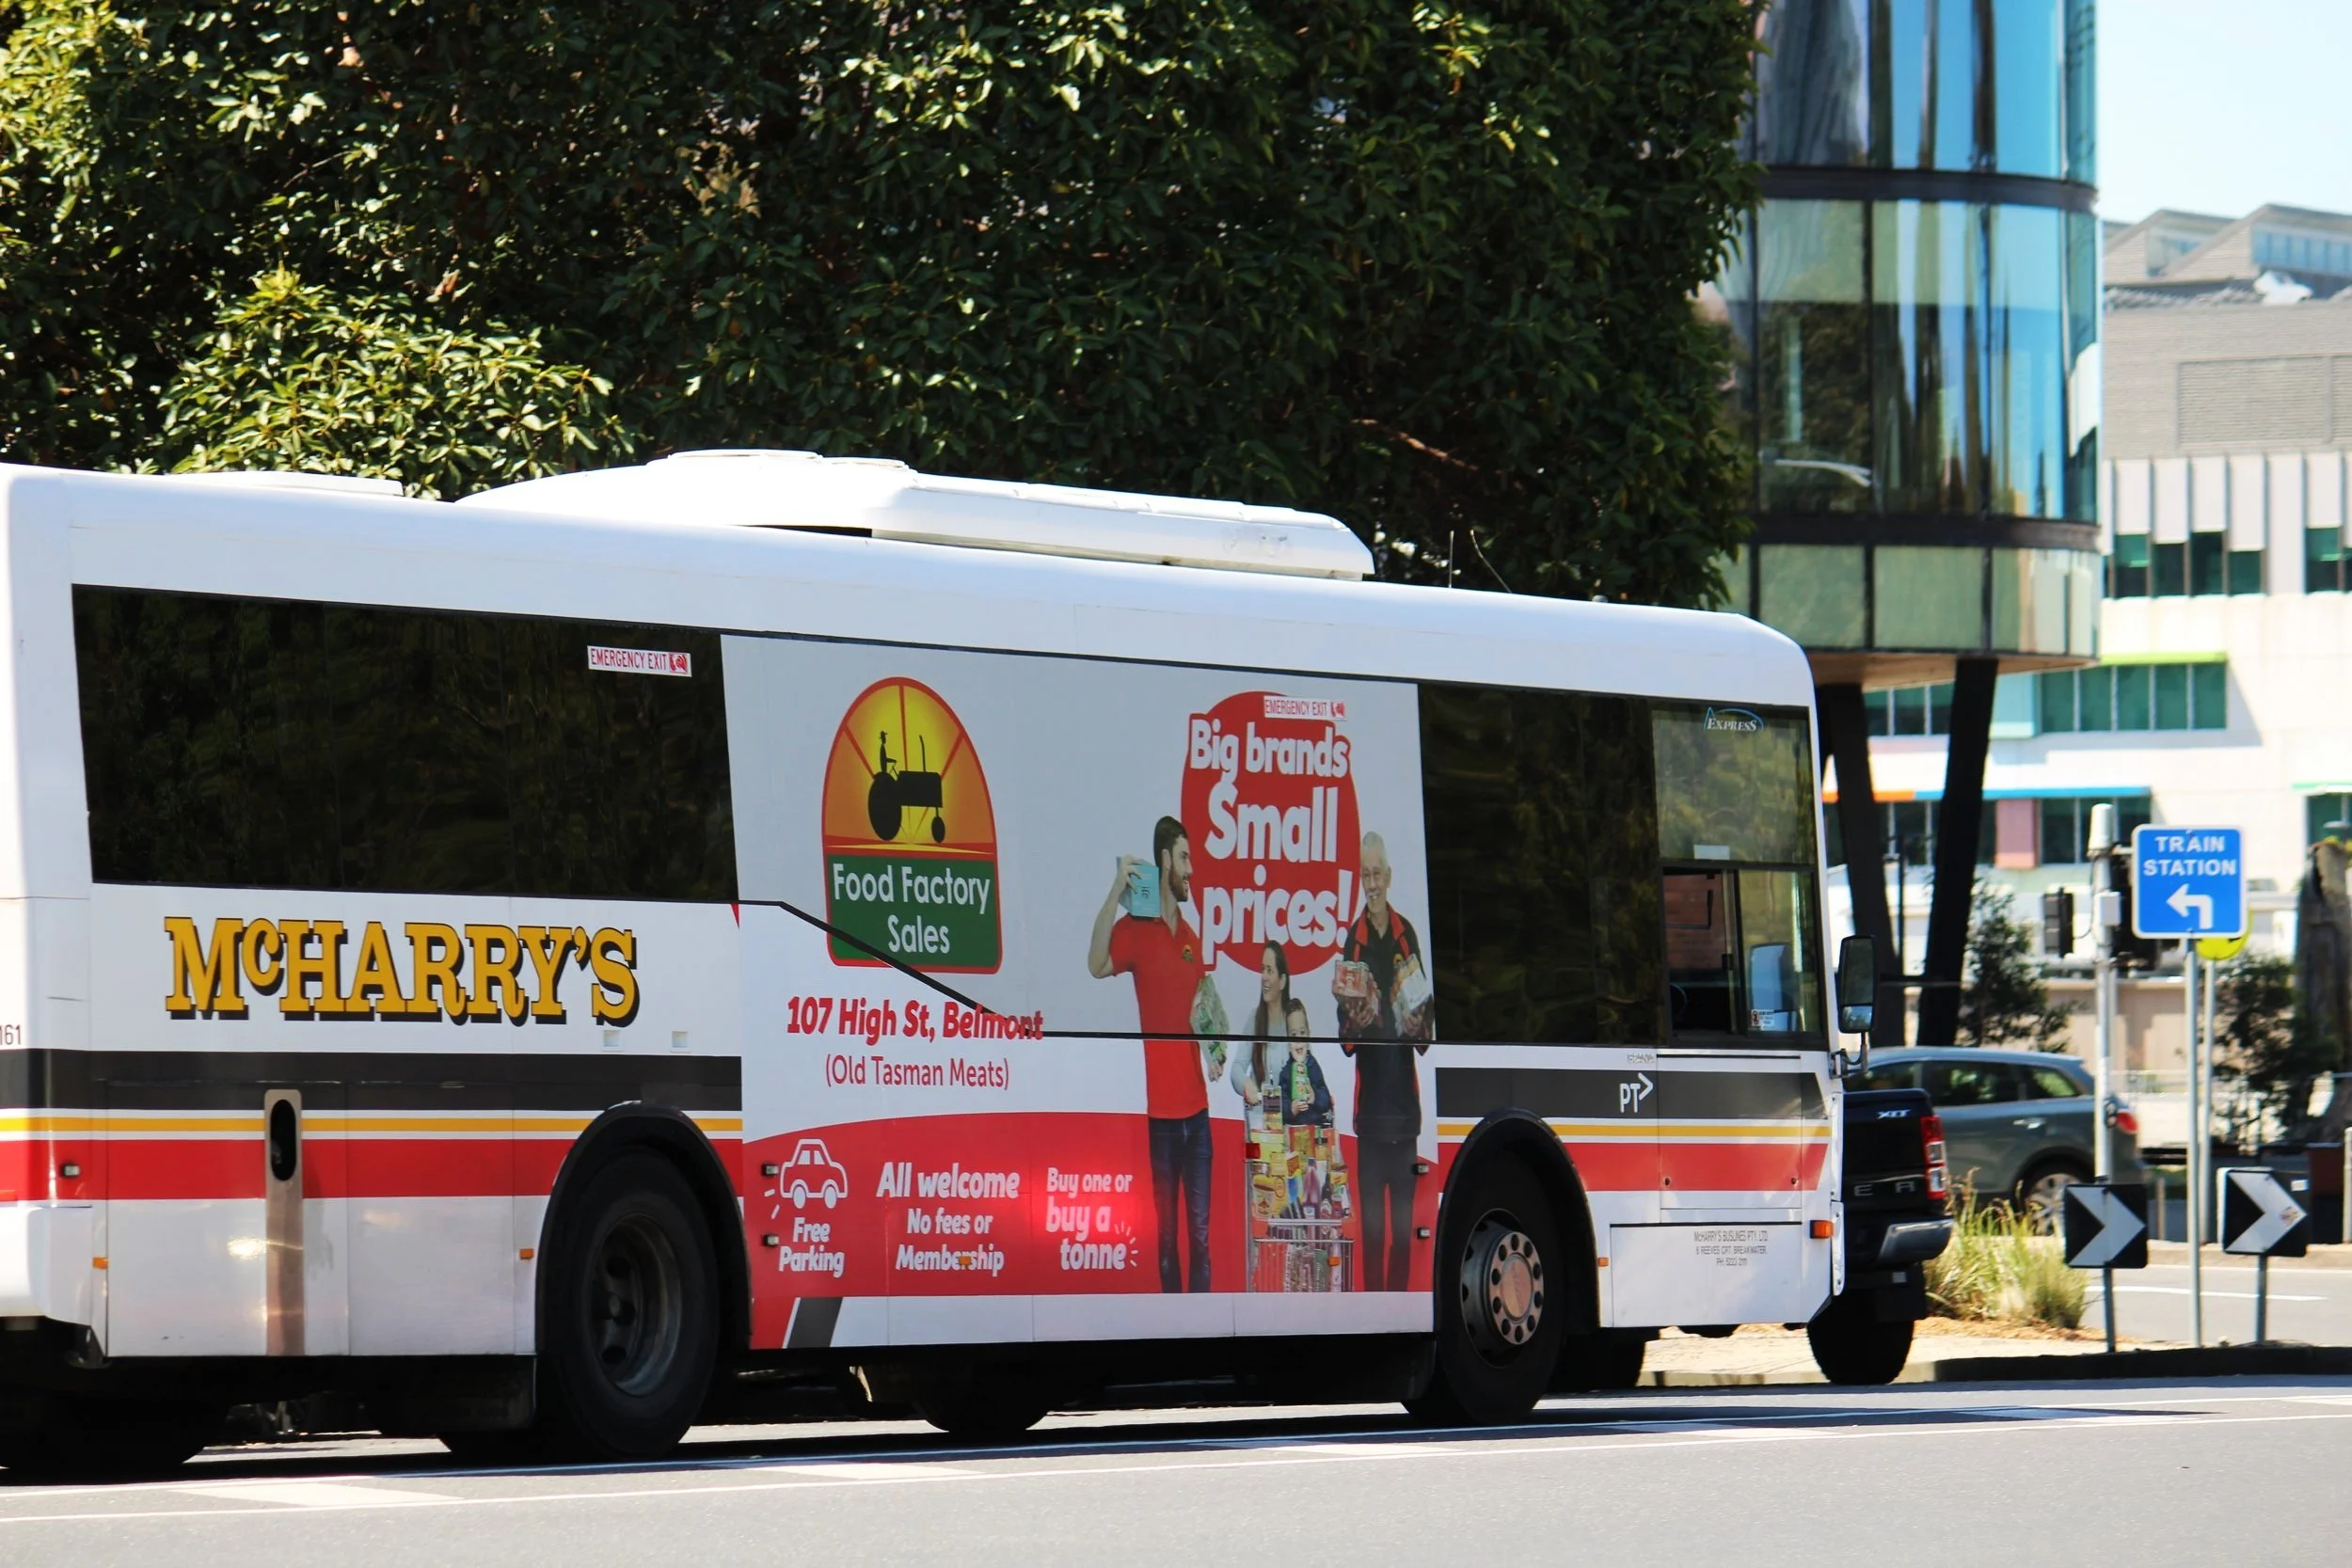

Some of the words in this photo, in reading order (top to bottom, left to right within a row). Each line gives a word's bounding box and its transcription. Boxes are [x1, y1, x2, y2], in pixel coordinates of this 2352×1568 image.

[590, 648, 645, 669] EMERGENCY
[648, 653, 667, 671] EXIT
[1265, 699, 1310, 715] EMERGENCY
[1312, 702, 1327, 716] EXIT
[1707, 718, 1757, 731] EXPRESS
[1190, 719, 1239, 783] Big
[1246, 721, 1350, 778] brands
[1204, 781, 1339, 863] Small
[2154, 835, 2225, 852] TRAIN
[2143, 859, 2236, 876] STATION
[833, 863, 894, 902] Food
[901, 866, 990, 915] Factory
[1201, 864, 1354, 965] prices!
[887, 914, 950, 954] Sales
[787, 995, 833, 1035] 107
[839, 998, 897, 1046] High
[902, 999, 935, 1043] St,
[943, 1001, 1043, 1041] Belmont
[825, 1053, 866, 1087] (Old
[871, 1055, 944, 1087] Tasman
[949, 1057, 1009, 1090] Meats)
[876, 1162, 913, 1198] All
[917, 1163, 1020, 1198] welcome
[1046, 1167, 1079, 1198] Buy
[1083, 1171, 1111, 1193] one
[1115, 1173, 1133, 1193] or
[792, 1216, 830, 1243] Free
[907, 1208, 932, 1234] No
[935, 1208, 971, 1235] fees
[974, 1212, 993, 1234] or
[1046, 1199, 1091, 1242] buy
[1095, 1202, 1111, 1232] a
[778, 1245, 845, 1278] Parking
[1060, 1237, 1127, 1270] tonne
